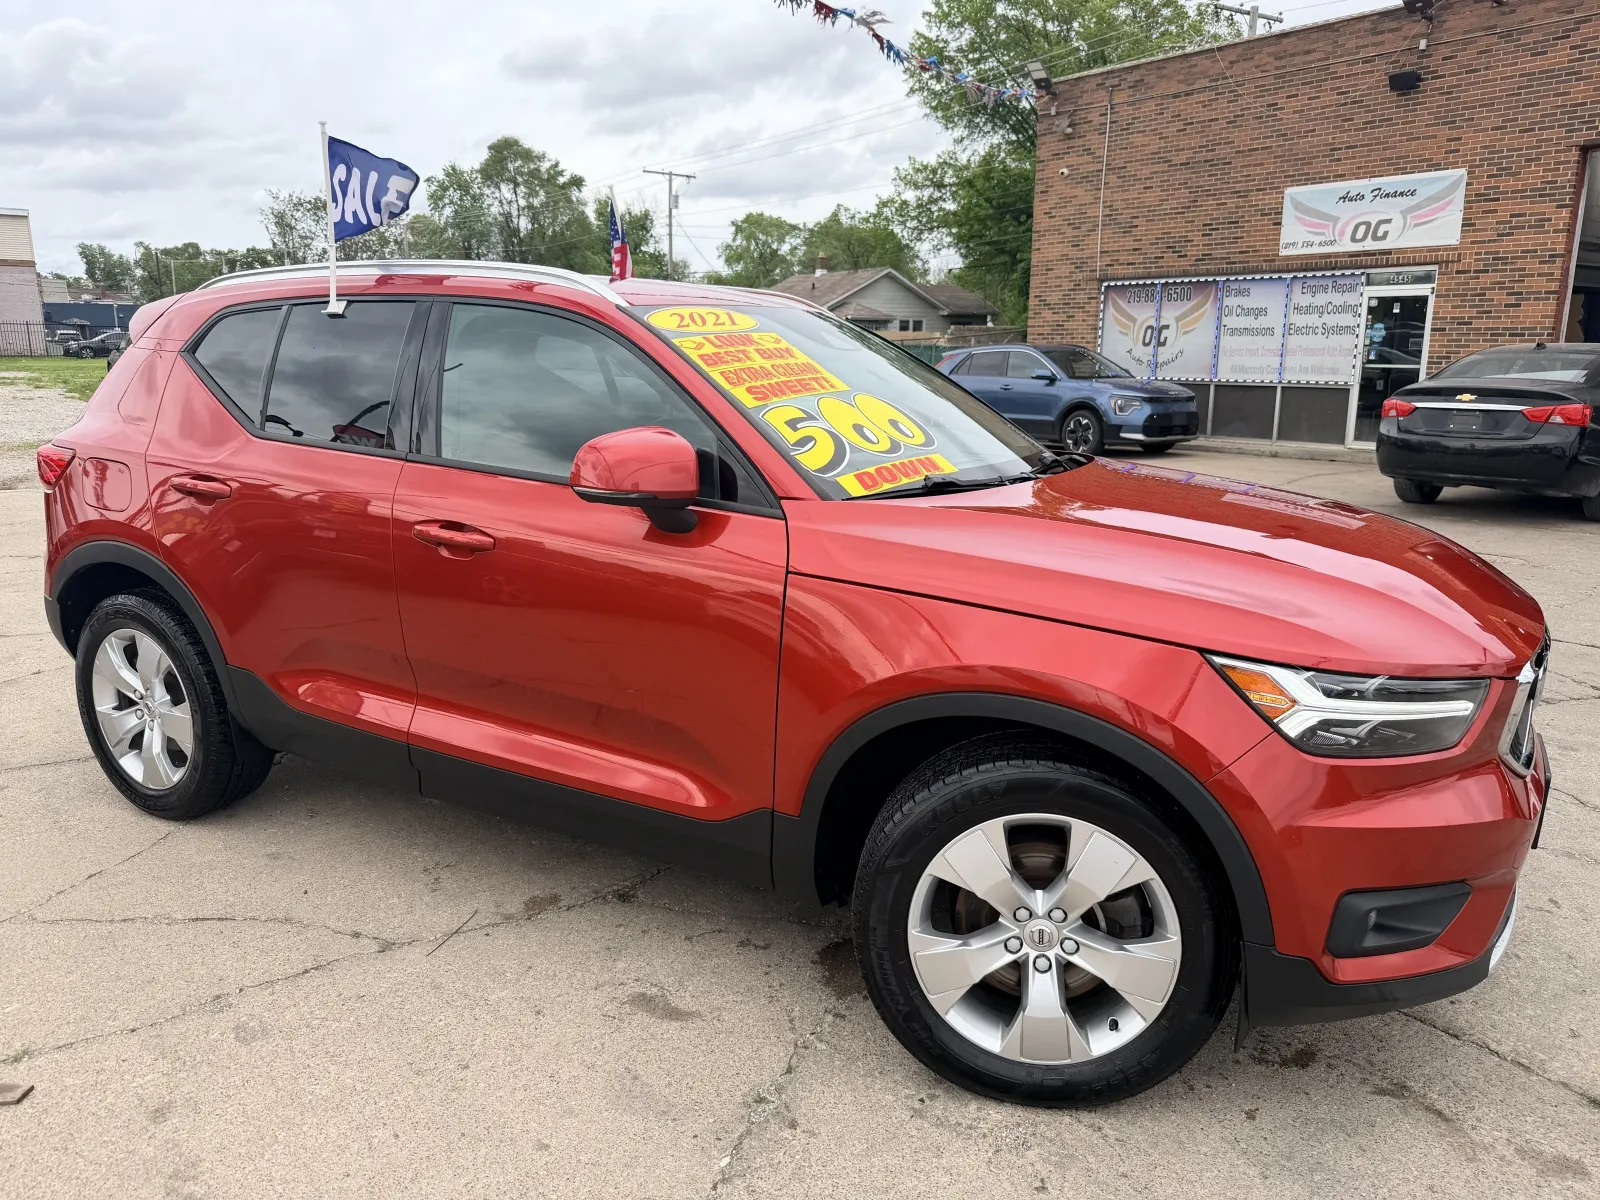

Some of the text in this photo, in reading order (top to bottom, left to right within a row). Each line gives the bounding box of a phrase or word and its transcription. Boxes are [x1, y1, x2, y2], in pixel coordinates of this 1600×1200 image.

[332, 163, 415, 227] SALE
[1335, 187, 1417, 204] Auto Finance
[1350, 218, 1393, 243] OG
[1281, 239, 1336, 250] (219) 884-6500
[1301, 279, 1359, 297] Engine Repair
[1390, 275, 1411, 283] 4545
[1225, 285, 1251, 298] Brakes
[1223, 304, 1268, 320] Oil Changes
[1292, 301, 1358, 318] Heating/Cooling
[669, 311, 740, 329] 2021
[1141, 324, 1170, 347] OG
[1222, 324, 1275, 337] Transmissions
[1288, 322, 1319, 336] Electric
[1321, 321, 1356, 339] Systems
[702, 333, 762, 350] LOOK
[696, 346, 798, 368] BEST BUY
[1125, 348, 1145, 366] Auto
[719, 361, 820, 386] EXTRA CLEAN
[1239, 364, 1265, 376] Warranty
[1310, 364, 1341, 376] Welcome
[745, 375, 834, 402] SWEET!
[759, 392, 938, 477] 500
[851, 456, 942, 492] DOWN
